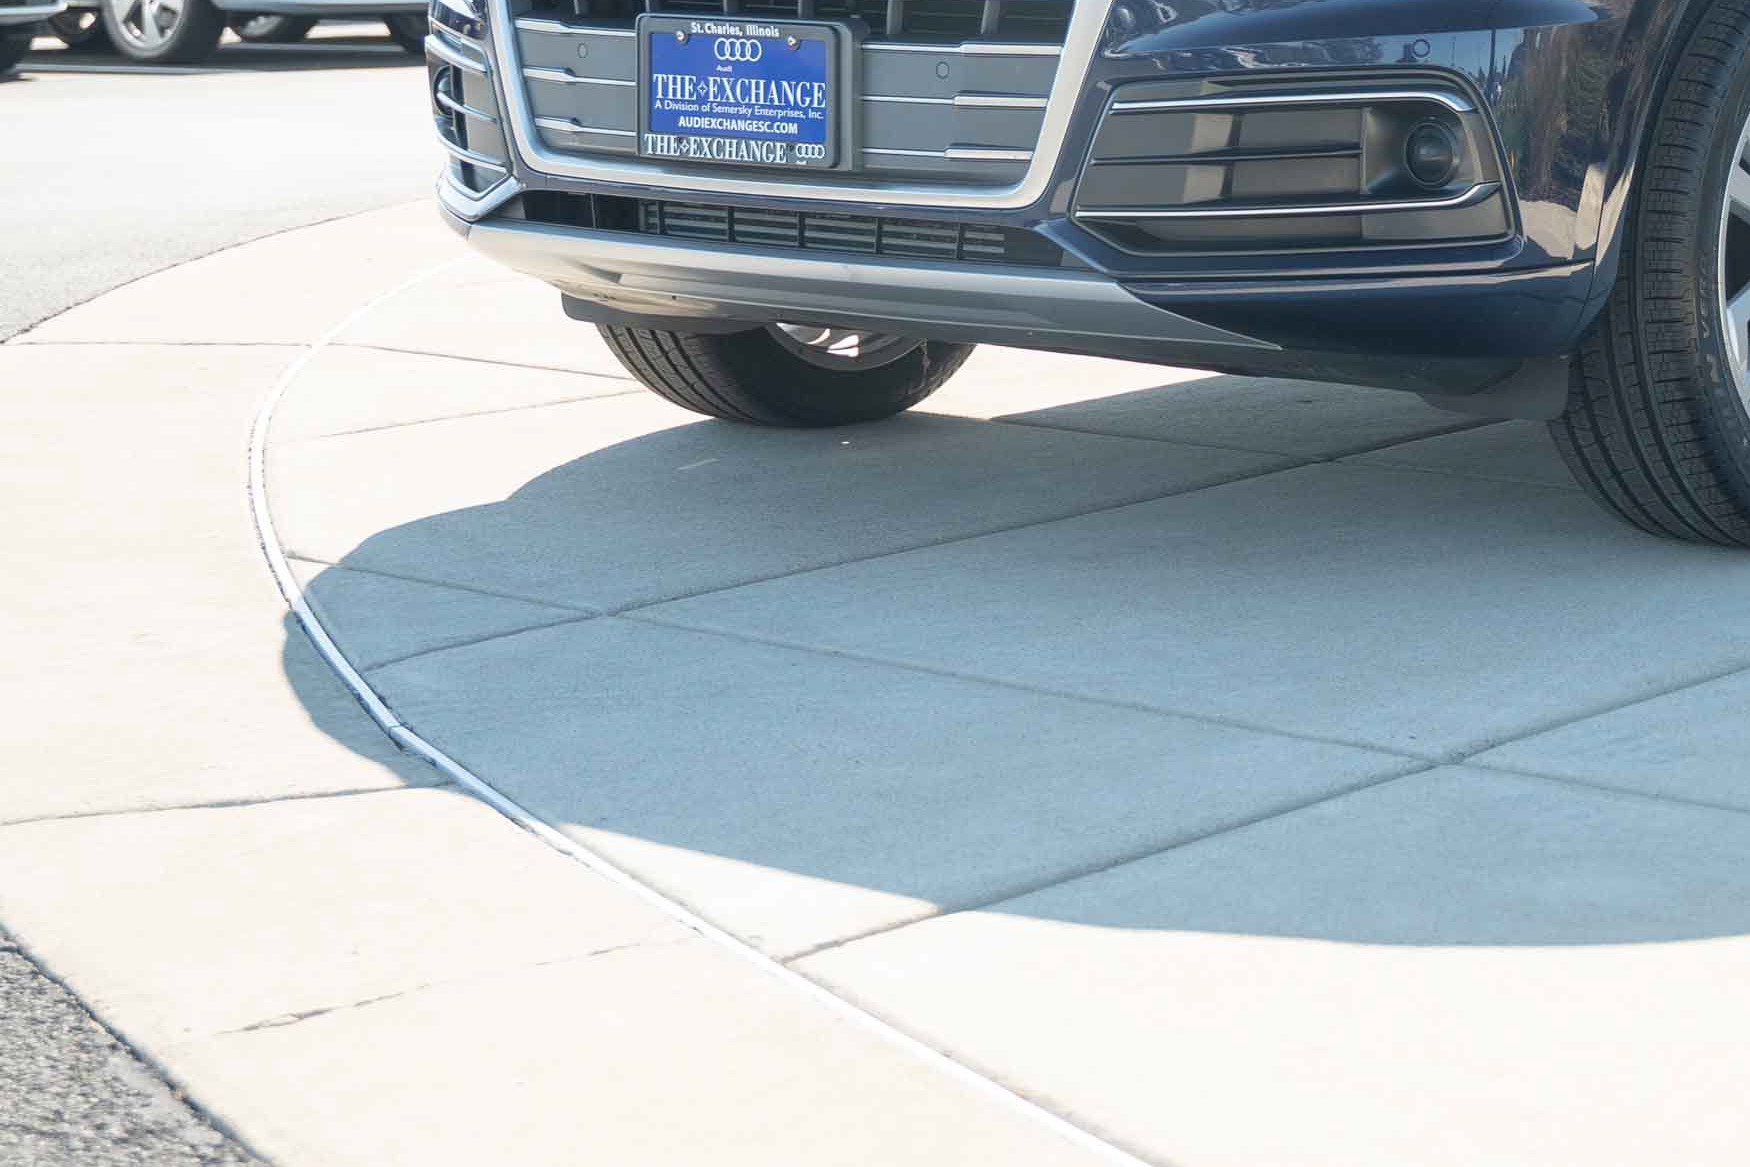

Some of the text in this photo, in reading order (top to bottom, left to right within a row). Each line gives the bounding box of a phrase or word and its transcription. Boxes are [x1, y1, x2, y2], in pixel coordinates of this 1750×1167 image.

[691, 22, 780, 37] St. Charles, Illinois
[653, 74, 826, 108] THE EXCHANGE
[655, 100, 824, 120] A Division of Semersky Enterprises, Inc.
[678, 116, 798, 135] AUDIEXCHANGESC.COM
[644, 134, 787, 164] THE EXCHANGE
